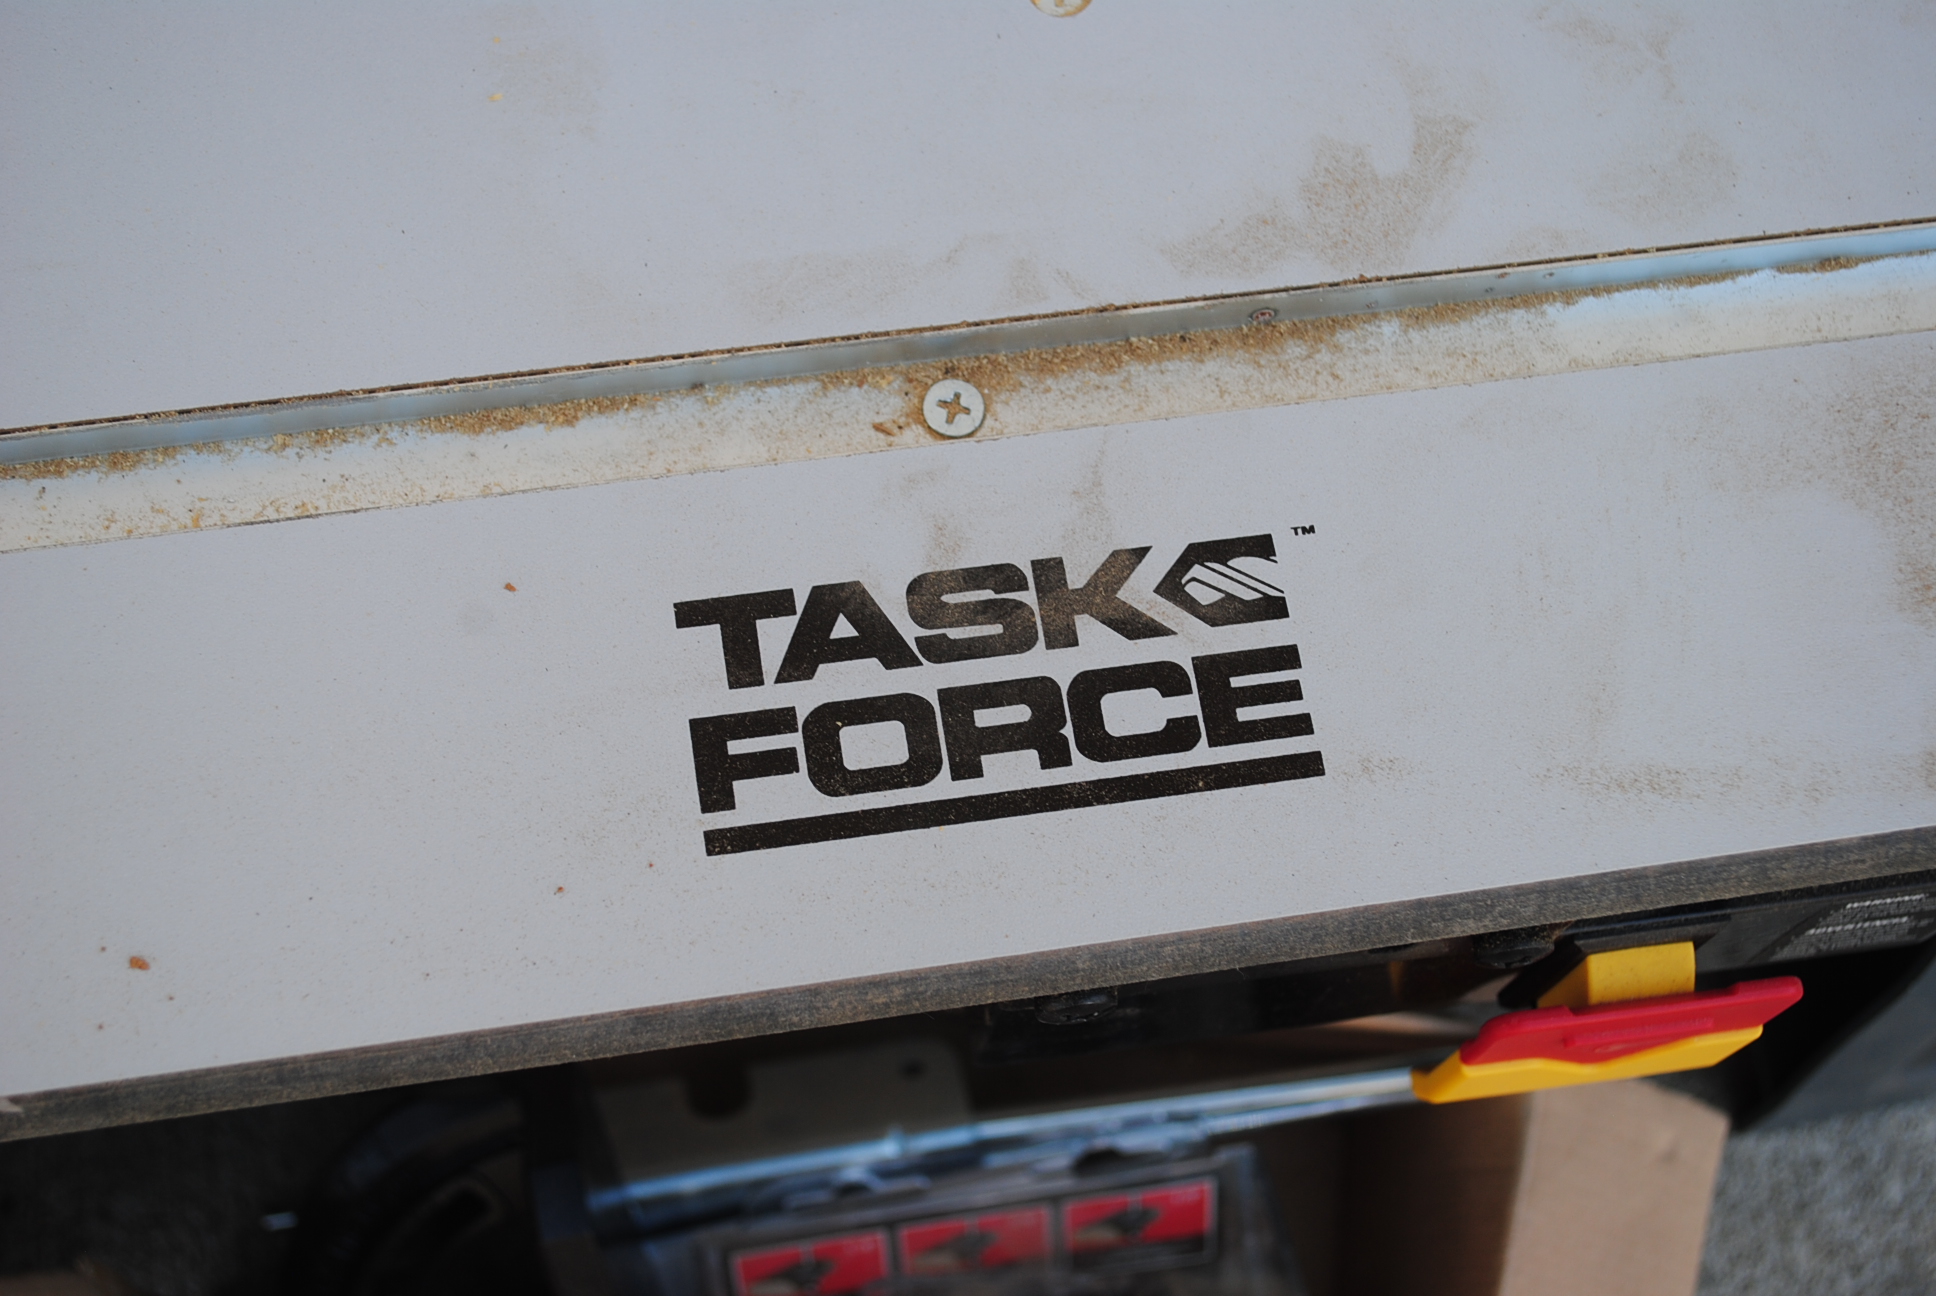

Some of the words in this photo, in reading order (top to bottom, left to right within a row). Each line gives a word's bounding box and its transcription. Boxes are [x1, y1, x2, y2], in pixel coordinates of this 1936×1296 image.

[673, 546, 1178, 690] TASK
[1290, 524, 1316, 536] TM
[689, 644, 1315, 815] FORCE
